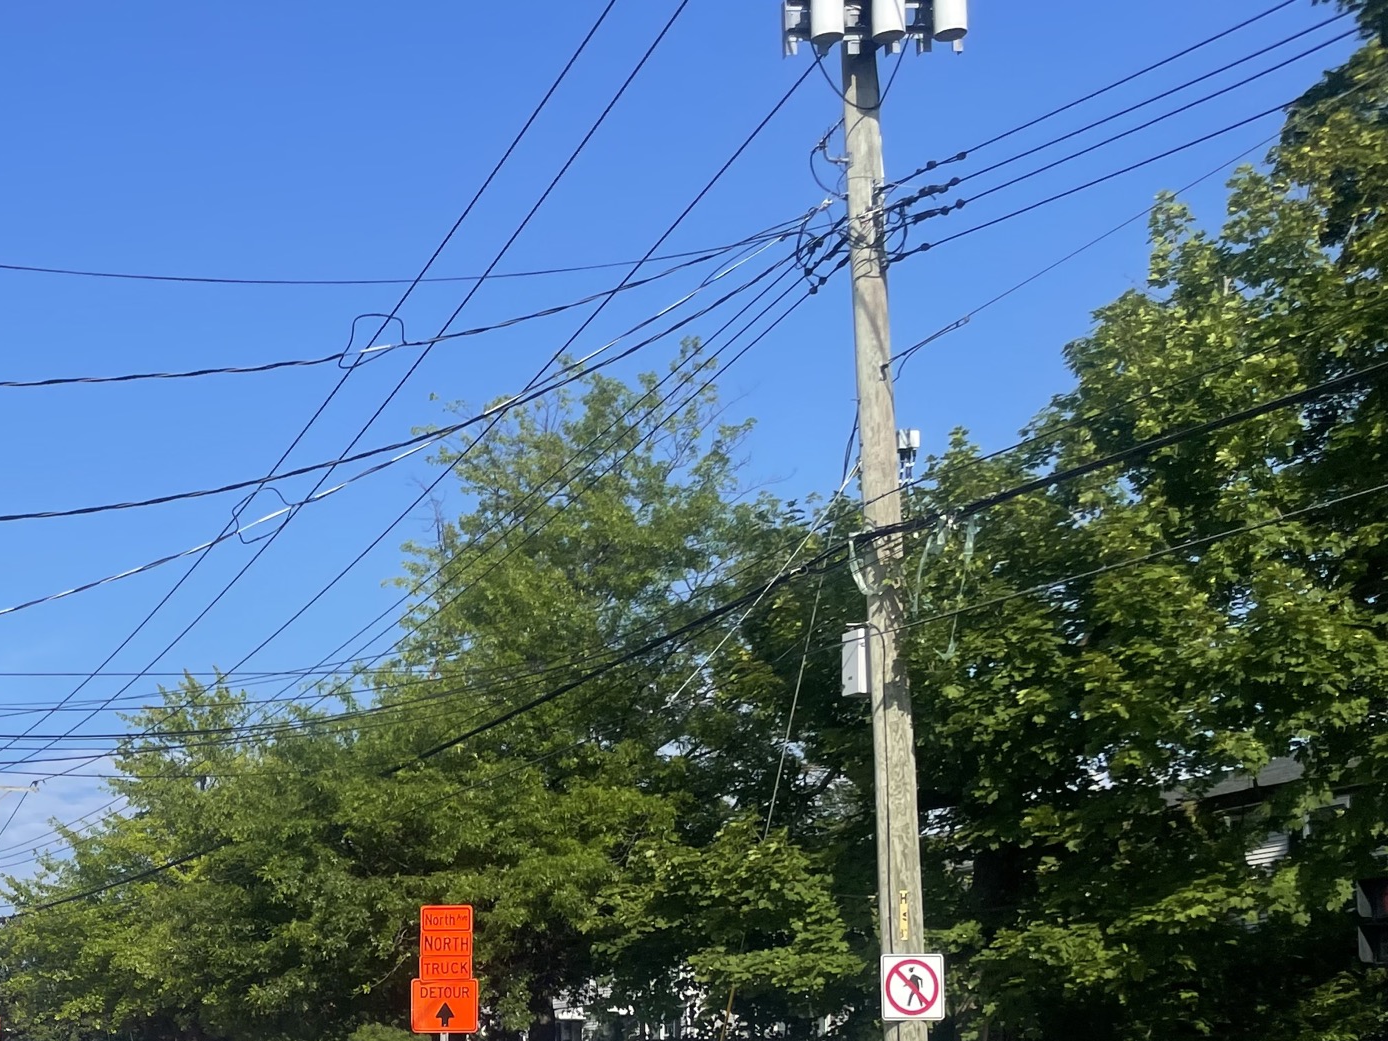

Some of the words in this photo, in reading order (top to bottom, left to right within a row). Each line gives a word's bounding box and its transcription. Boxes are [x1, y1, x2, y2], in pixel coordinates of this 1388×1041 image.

[424, 913, 455, 926] North
[456, 913, 468, 921] Ave
[424, 936, 469, 952] NORTH
[423, 962, 469, 975] TRUCK
[420, 986, 470, 998] DETOUR
